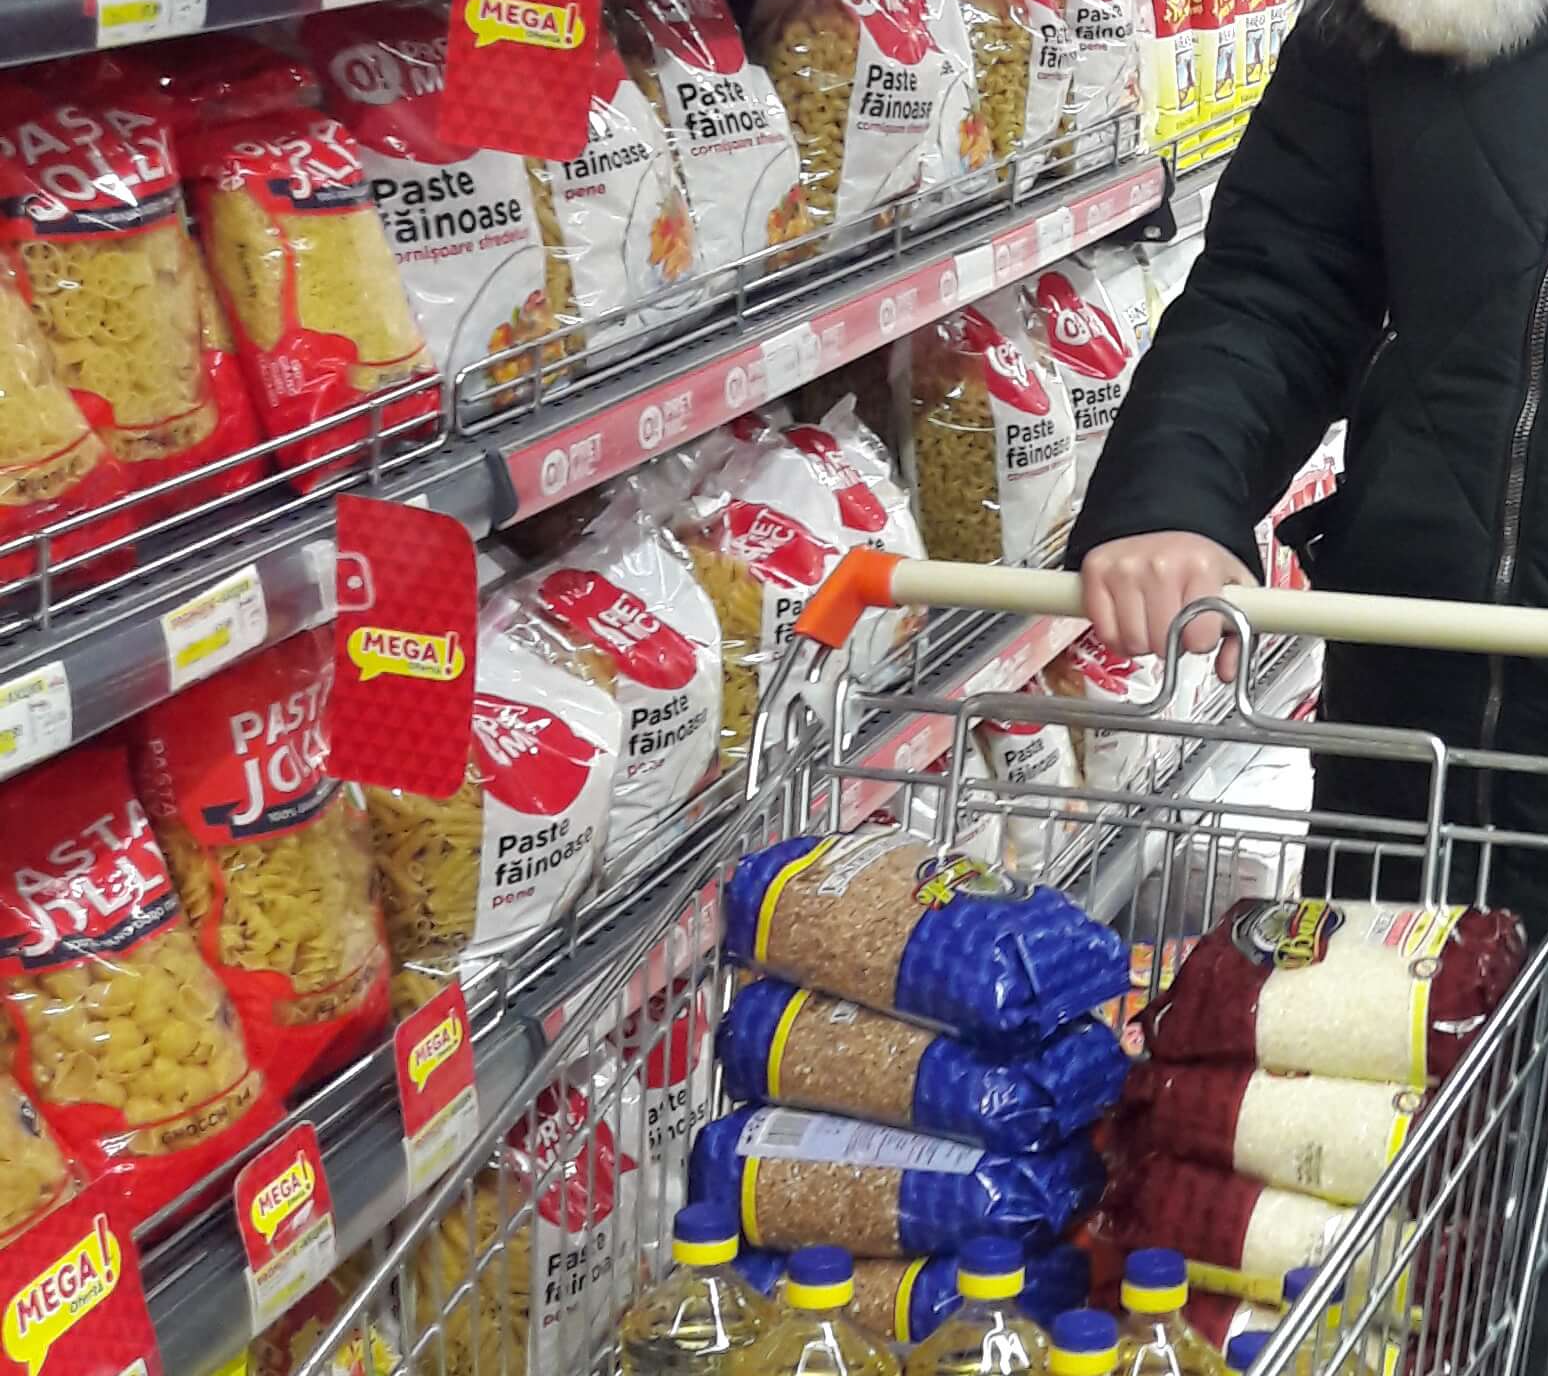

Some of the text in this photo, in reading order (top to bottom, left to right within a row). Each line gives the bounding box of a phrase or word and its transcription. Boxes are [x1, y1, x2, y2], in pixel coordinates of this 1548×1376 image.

[677, 78, 745, 111] Paste
[865, 64, 918, 92] Paste
[859, 91, 933, 120] făinoase
[372, 168, 476, 208] Paste
[1071, 381, 1121, 409] Paste
[1006, 419, 1055, 446] Paste
[1074, 406, 1120, 431] făino
[631, 693, 690, 732] Paste
[14, 798, 150, 898] ASTA
[498, 818, 571, 860] Paste
[495, 824, 595, 890] făinoase
